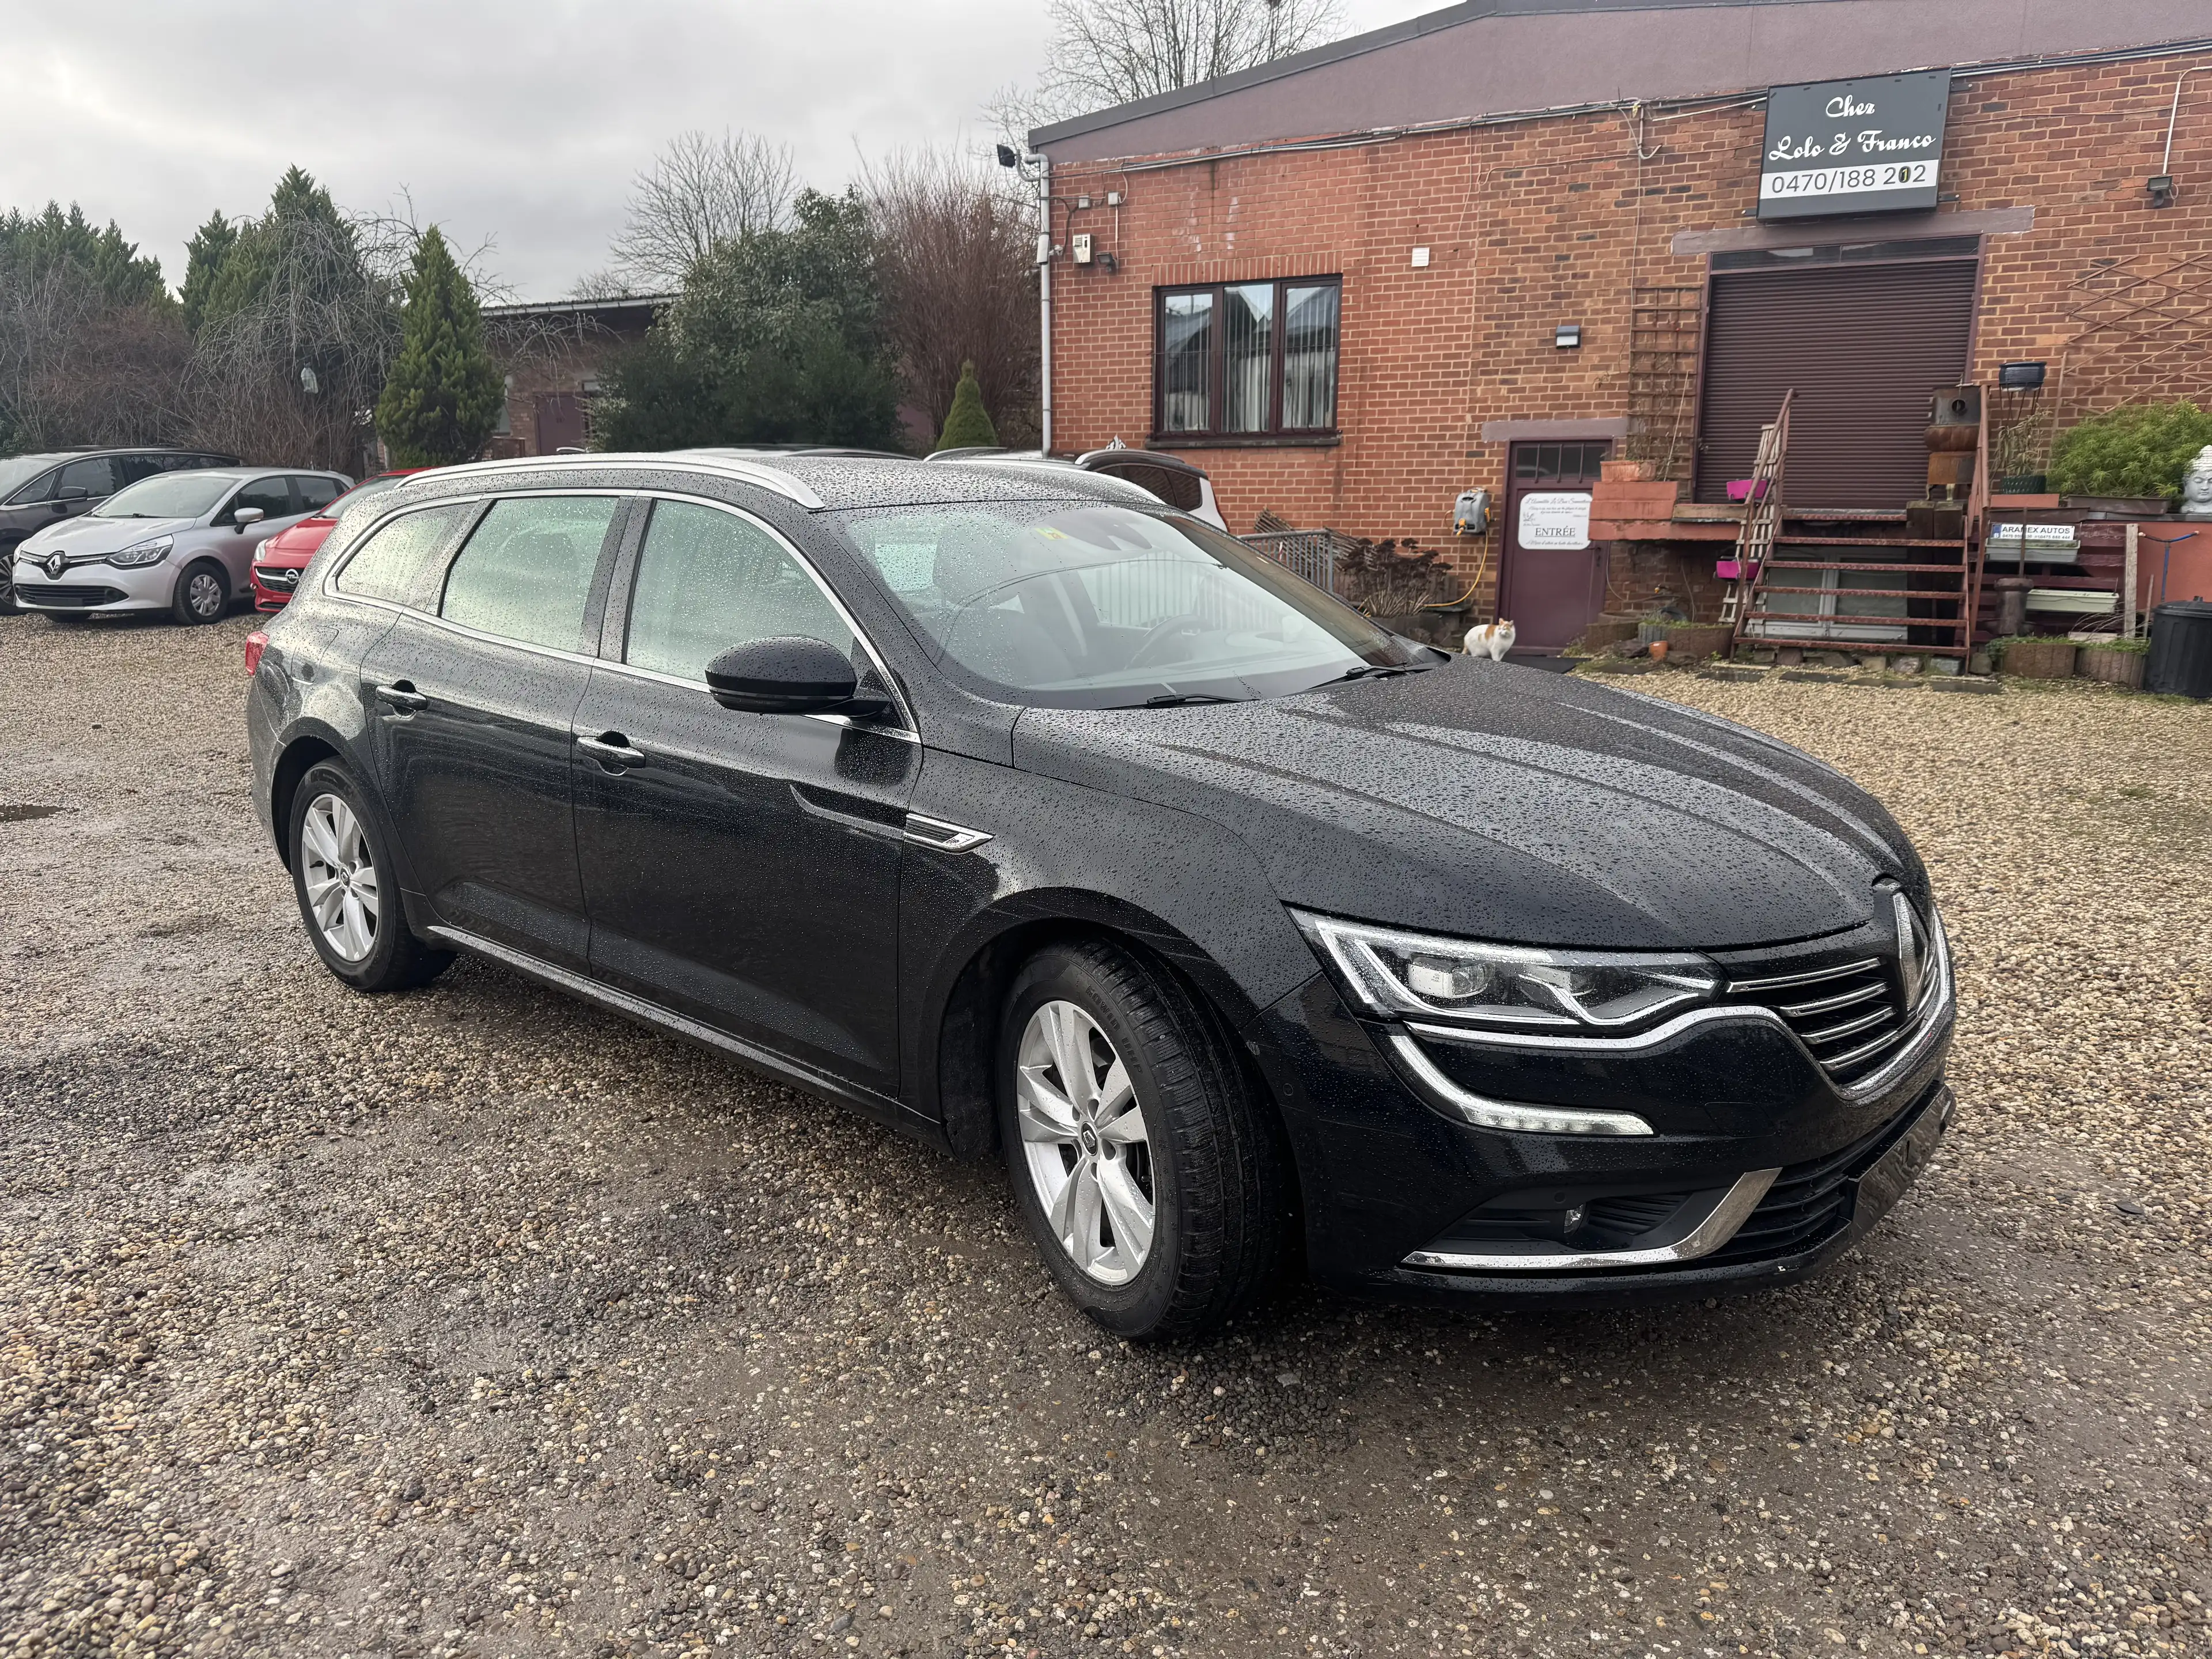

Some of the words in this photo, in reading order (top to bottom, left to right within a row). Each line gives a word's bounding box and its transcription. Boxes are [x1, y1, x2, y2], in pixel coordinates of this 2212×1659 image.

[1825, 94, 1875, 118] Chez
[1768, 135, 1825, 161] Lolo
[1829, 132, 1851, 156] &
[1857, 130, 1937, 153] Franco
[1772, 169, 1876, 194] 0470/188
[1535, 526, 1575, 536] ENTRÉE
